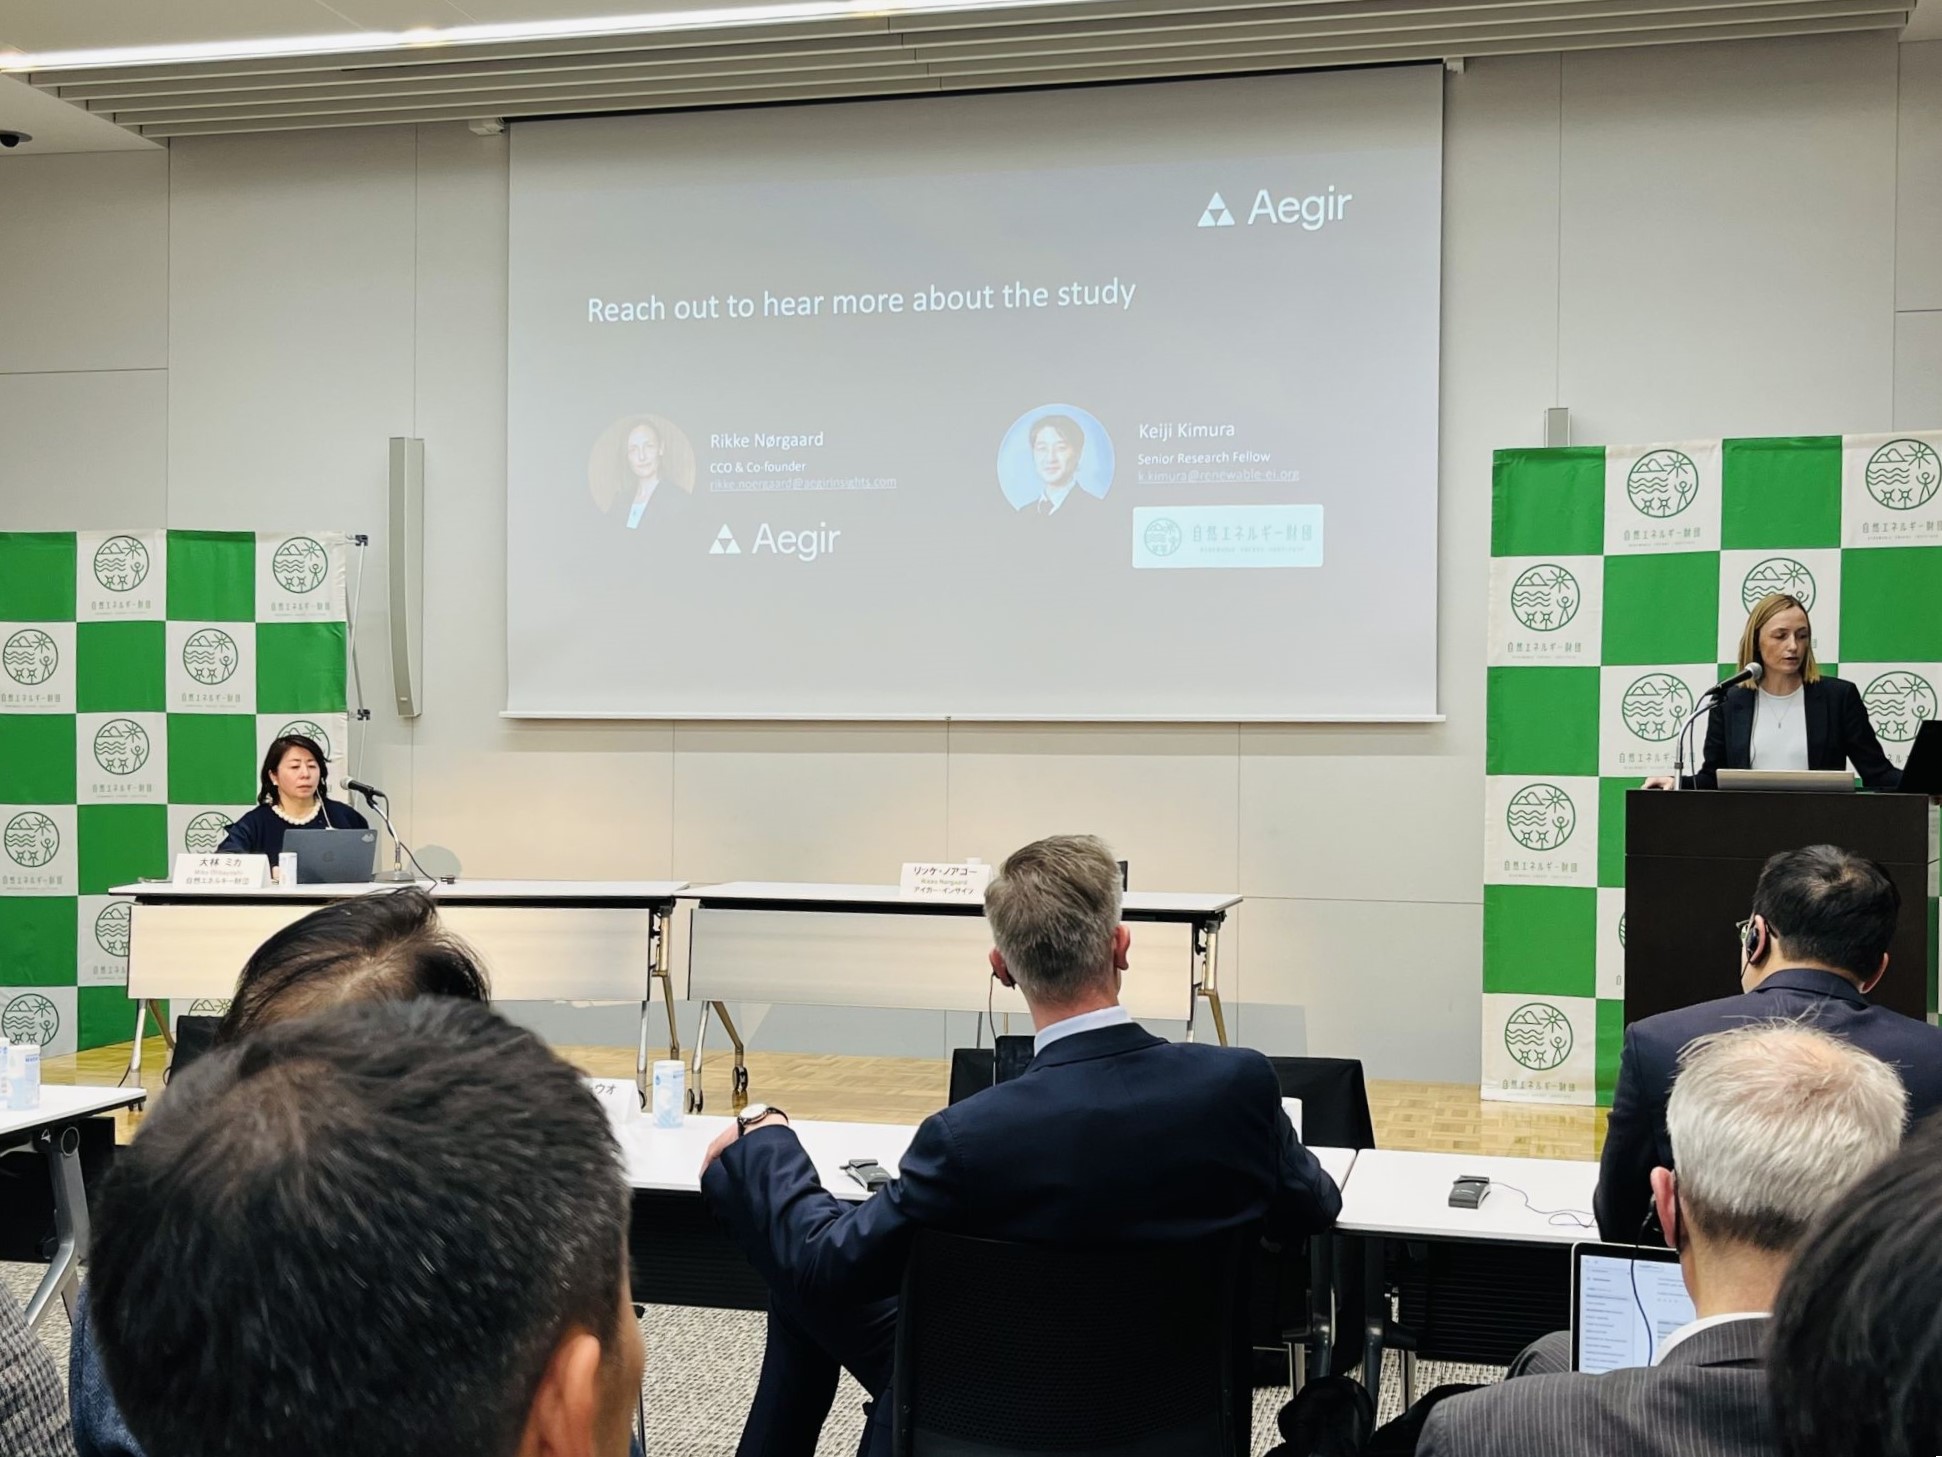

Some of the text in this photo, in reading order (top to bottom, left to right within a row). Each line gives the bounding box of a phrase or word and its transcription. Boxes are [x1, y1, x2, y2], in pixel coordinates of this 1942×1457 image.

[1247, 184, 1353, 231] Aegir
[588, 277, 1136, 322] Reach out to hear more about the study
[710, 431, 824, 450] Rikke Nørgaard
[1139, 422, 1235, 441] Keiji Kimura
[710, 460, 807, 474] CCO & Co-founder
[1137, 450, 1271, 465] Senior Research Fellow
[751, 521, 841, 561] Aegir
[1192, 523, 1313, 542] 自然エネルギー財団
